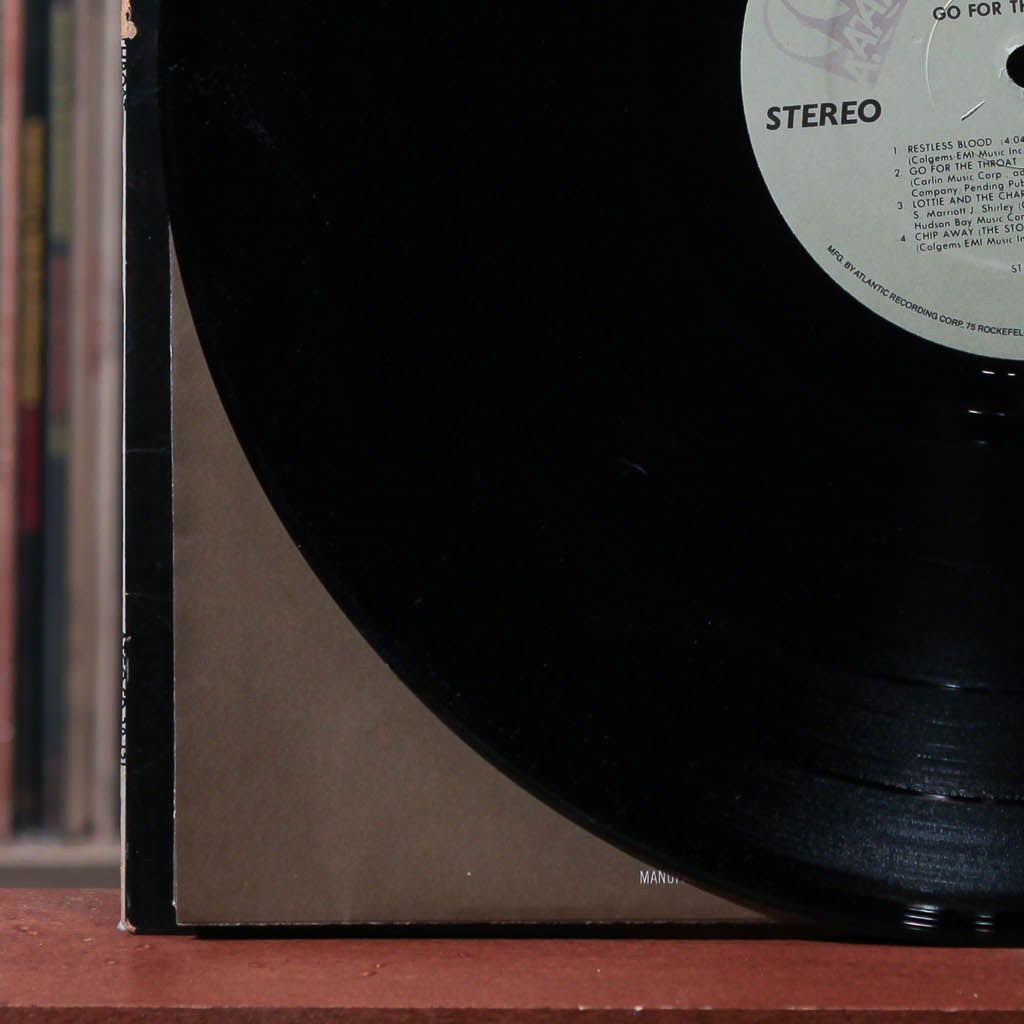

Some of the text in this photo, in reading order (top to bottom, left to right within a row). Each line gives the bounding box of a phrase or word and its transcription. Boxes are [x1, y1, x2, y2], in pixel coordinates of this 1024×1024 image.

[932, 5, 961, 21] GO
[968, 1, 1002, 18] FOR
[766, 98, 882, 131] STEREO
[844, 261, 857, 273] BY
[854, 270, 890, 297] ATLANTIC
[889, 292, 939, 321] RECORDING
[966, 322, 977, 331] 75
